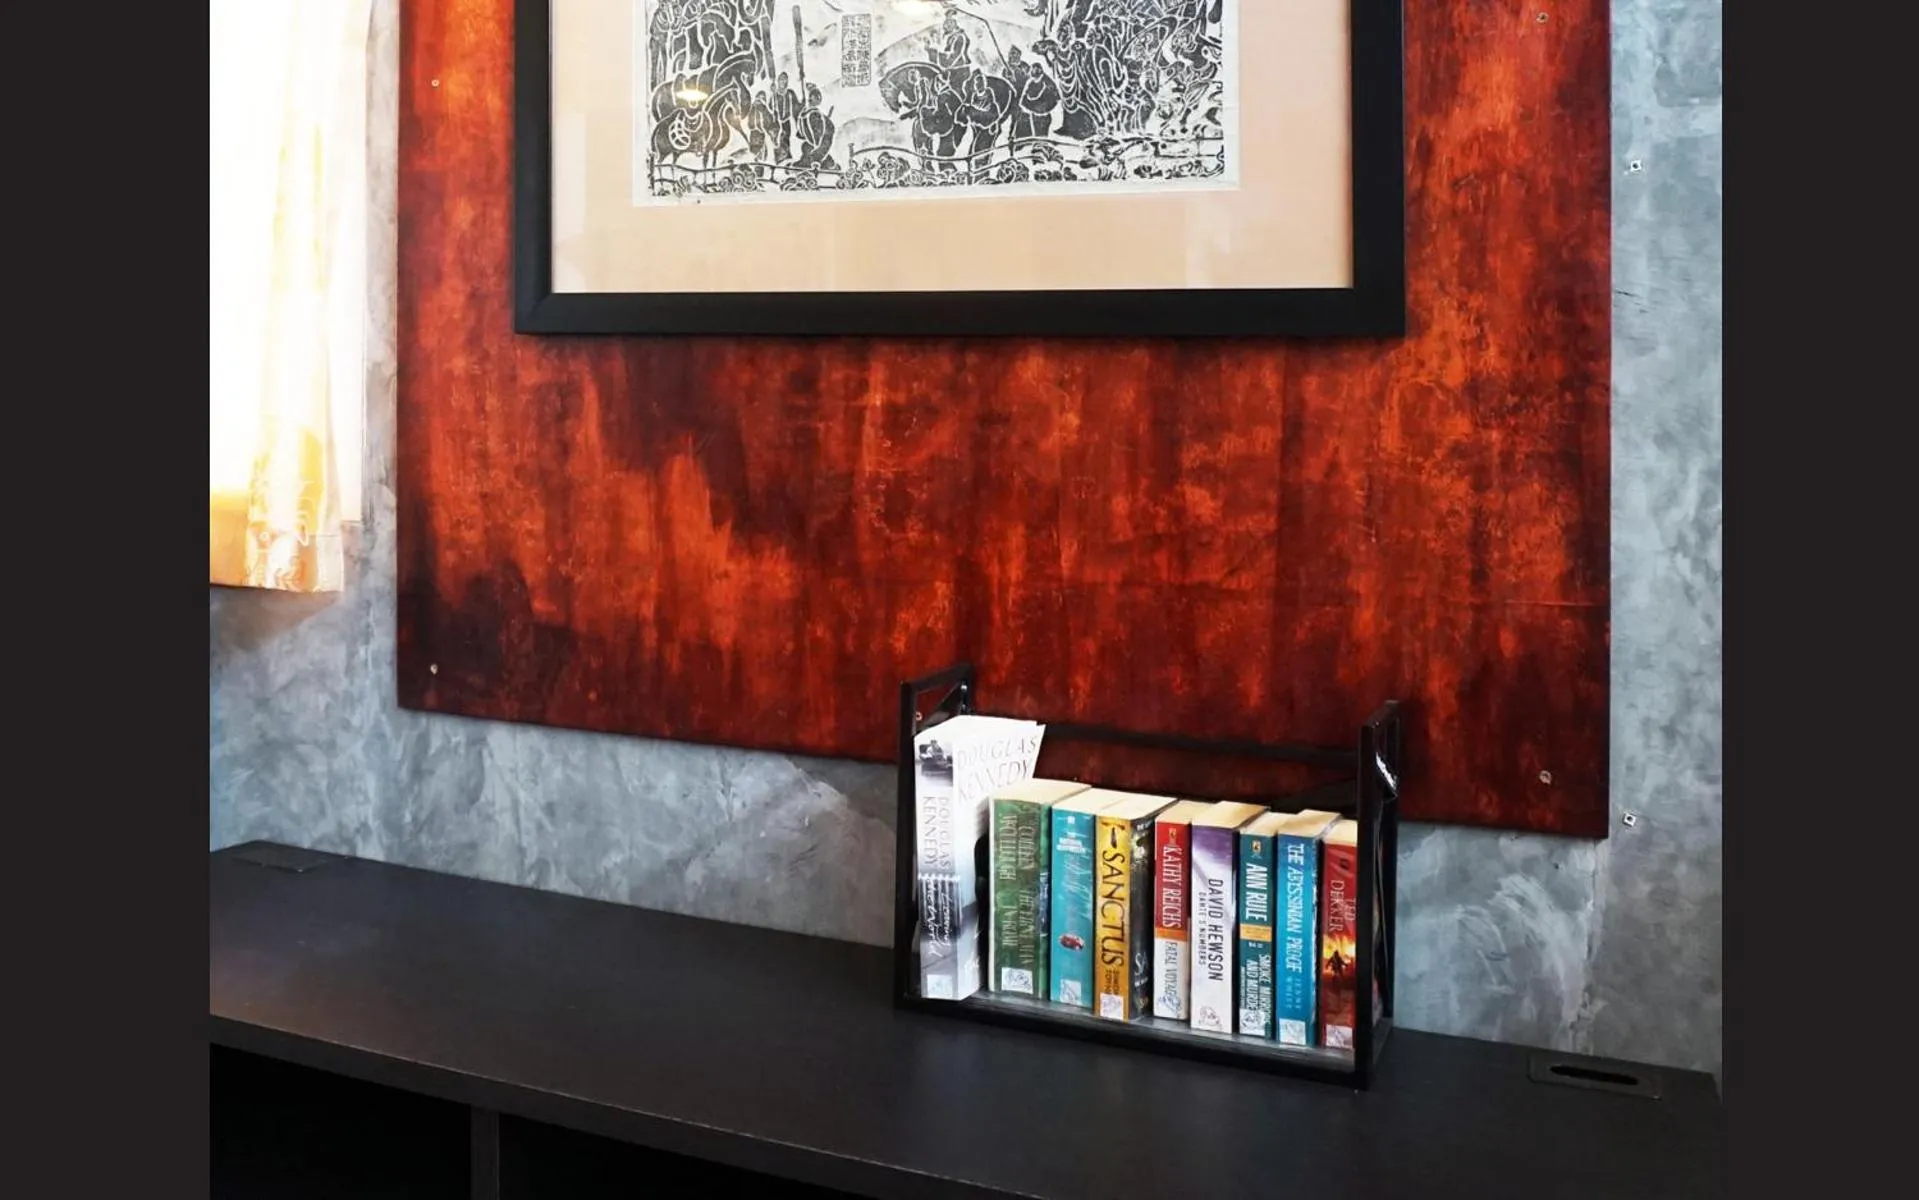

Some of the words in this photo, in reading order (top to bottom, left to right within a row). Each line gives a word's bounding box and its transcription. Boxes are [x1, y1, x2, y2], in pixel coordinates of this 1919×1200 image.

[957, 735, 1038, 771] DOUGLAS
[923, 796, 938, 865] KENNEDY
[938, 797, 952, 869] DOUGLAS
[1162, 846, 1182, 886] KATHY
[1287, 843, 1305, 866] THE
[1245, 862, 1268, 890] ANN
[1101, 850, 1126, 967] SANCTUS
[1162, 887, 1182, 928] REICHS
[1208, 879, 1224, 919] DAVID
[1245, 891, 1268, 922] RULE
[1286, 866, 1304, 933] ABYSSINIAN
[1329, 880, 1345, 932] DEKKER
[1343, 897, 1357, 922] TED
[1165, 942, 1178, 965] FATAL
[1208, 924, 1224, 981] HEWSON
[1246, 960, 1258, 978] AND
[1286, 937, 1303, 974] PROOF
[1165, 968, 1178, 997] VOYAG
[1246, 979, 1259, 1011] MURDE
